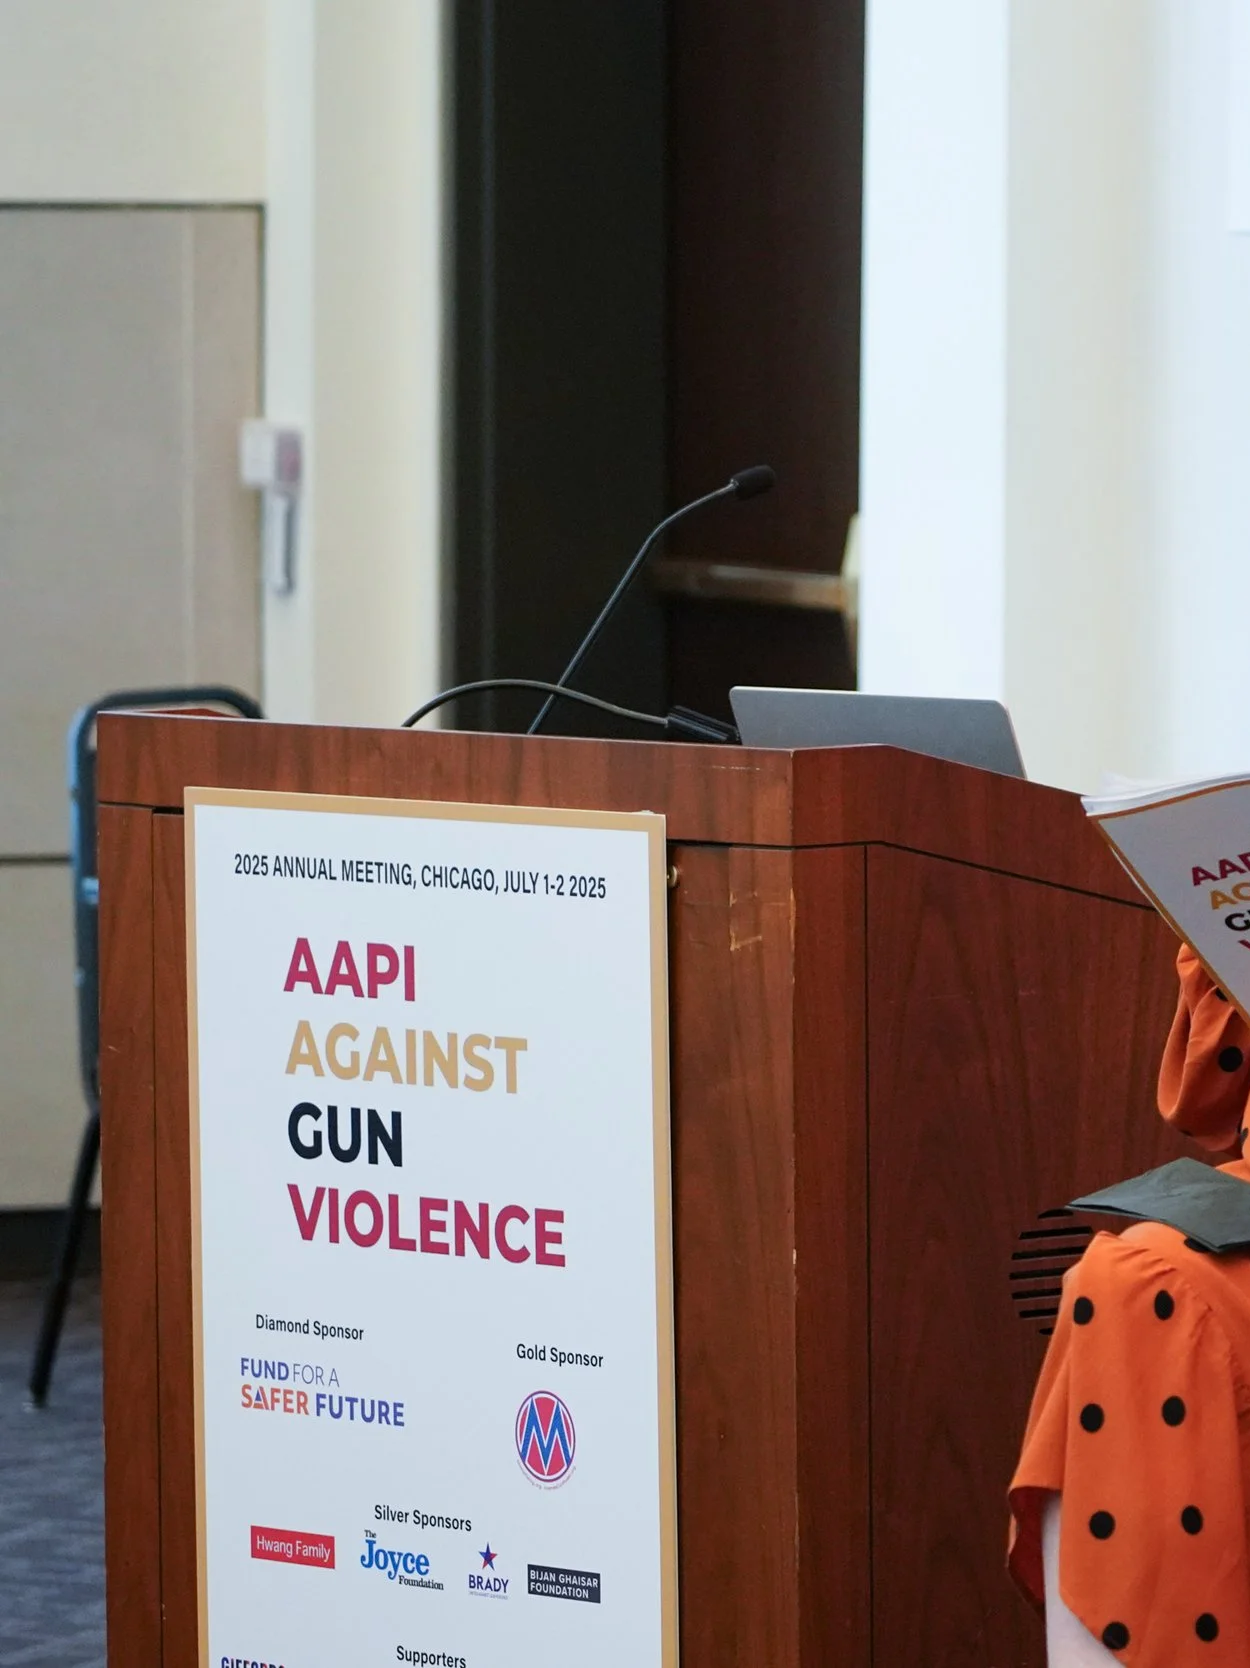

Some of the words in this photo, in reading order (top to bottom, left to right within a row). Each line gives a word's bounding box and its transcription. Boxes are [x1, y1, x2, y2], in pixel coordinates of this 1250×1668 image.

[234, 853, 269, 876] 2025
[273, 855, 337, 881] ANNUAL
[341, 859, 417, 889] MEETING,
[421, 864, 499, 895] CHICAGO,
[503, 870, 539, 894] JULY
[543, 873, 565, 896] 1-2
[569, 875, 606, 899] 2025
[283, 937, 416, 1002] AAPI
[285, 1019, 528, 1094] AGAINST
[287, 1101, 403, 1168] GUN
[286, 1183, 566, 1267] VIOLENCE
[256, 1314, 310, 1335] Diamond
[313, 1320, 364, 1340] Sponsor
[516, 1343, 546, 1361] Gold
[550, 1347, 603, 1367] Sponsor
[240, 1357, 289, 1381] FUND
[292, 1363, 325, 1386] FOR
[328, 1367, 340, 1388] A
[241, 1383, 310, 1416] SAFER
[315, 1393, 405, 1427] FUTURE
[374, 1504, 409, 1524] Silver
[412, 1509, 472, 1532] Sponsors
[364, 1529, 377, 1539] The
[256, 1535, 293, 1558] Hwang
[296, 1540, 331, 1563] Family
[360, 1538, 430, 1580] Joyce
[398, 1574, 444, 1591] Foundation
[468, 1573, 509, 1594] BRADY
[530, 1569, 556, 1582] BIJAN
[558, 1573, 599, 1588] GHAISAR
[530, 1581, 589, 1599] FOUNDATION
[396, 1645, 467, 1668] Supporters
